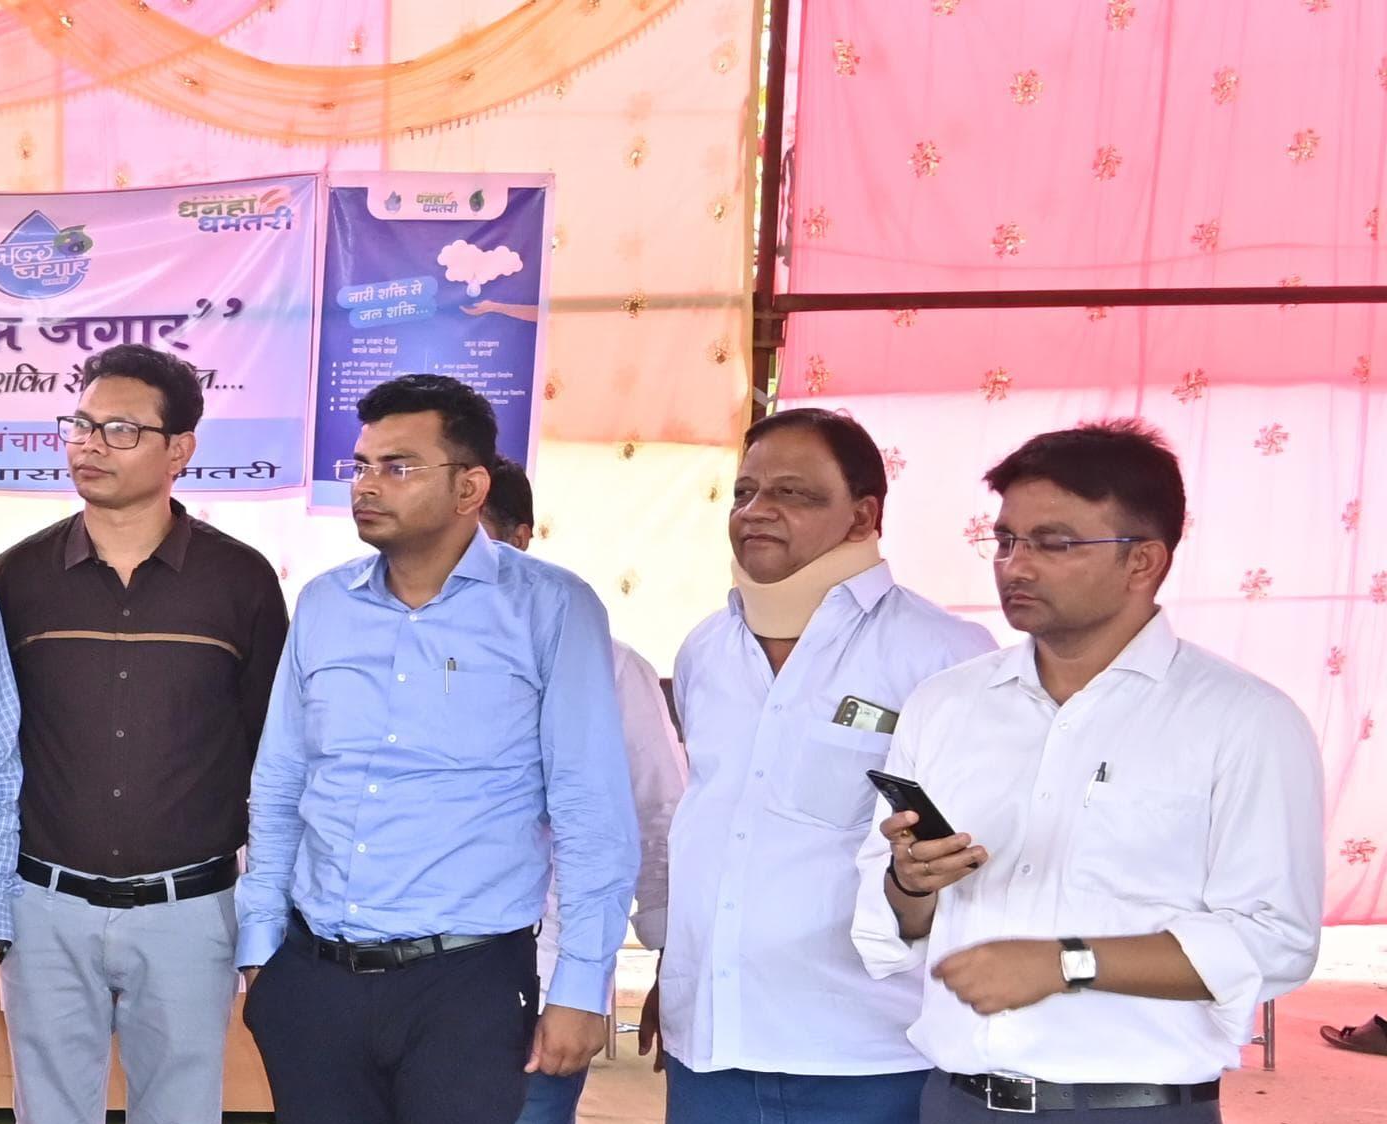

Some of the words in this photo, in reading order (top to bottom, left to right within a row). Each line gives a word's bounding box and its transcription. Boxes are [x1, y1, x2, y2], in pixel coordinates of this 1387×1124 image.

[197, 205, 294, 232] धमतरी
[348, 286, 375, 303] नारी
[377, 282, 409, 300] शक्ति
[410, 280, 423, 296] से
[359, 308, 383, 321] जल
[175, 461, 282, 479] मतरी
